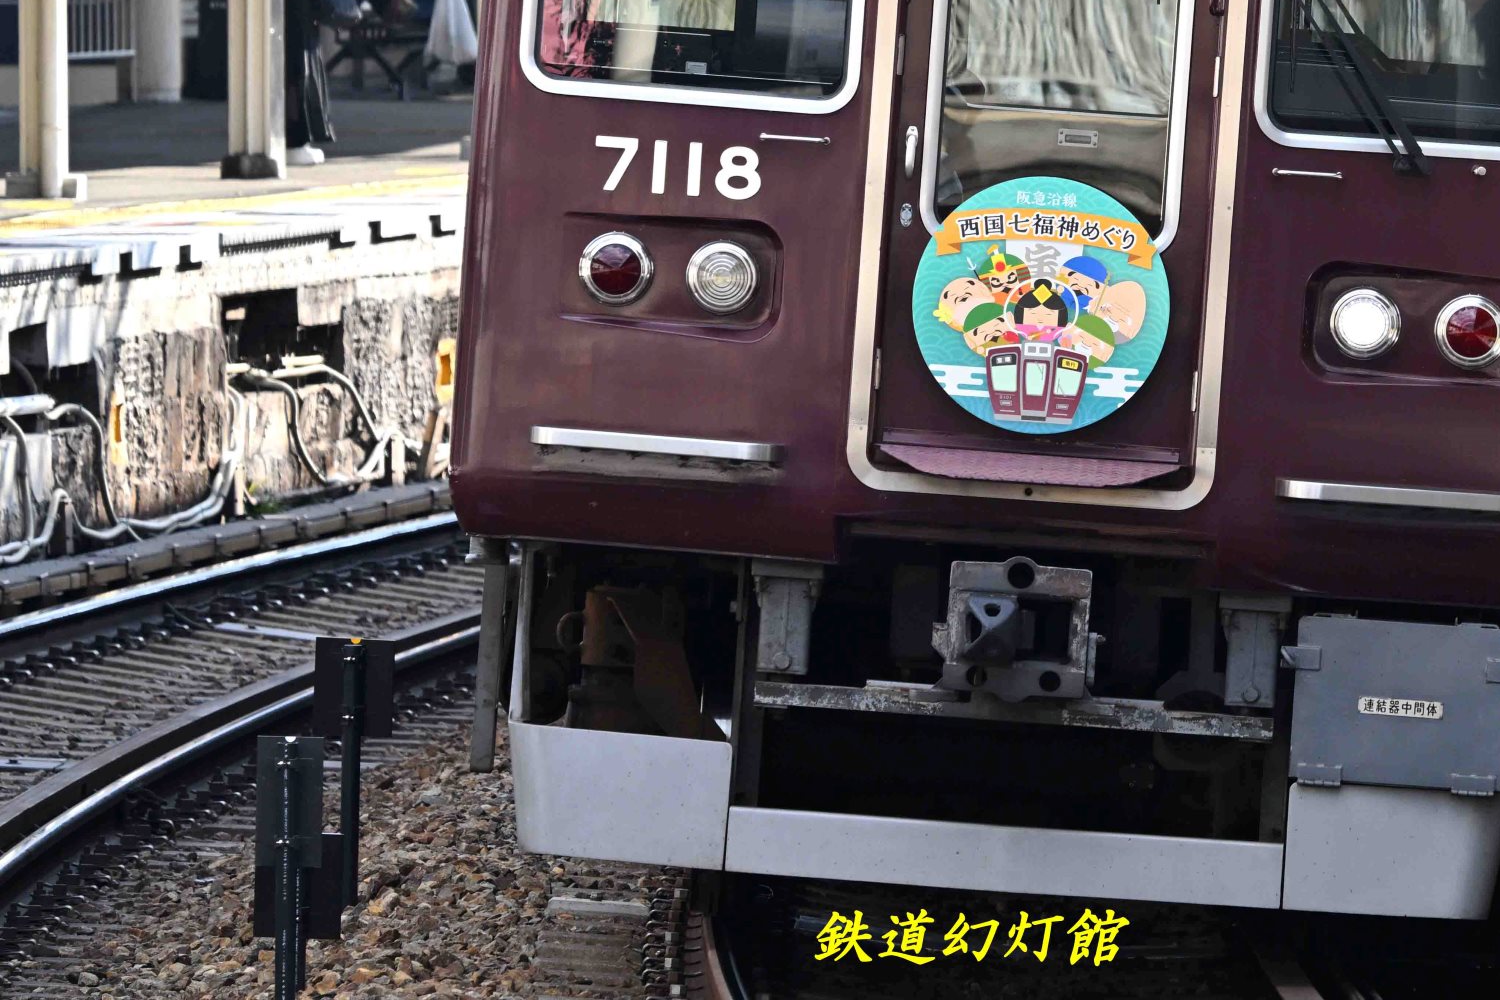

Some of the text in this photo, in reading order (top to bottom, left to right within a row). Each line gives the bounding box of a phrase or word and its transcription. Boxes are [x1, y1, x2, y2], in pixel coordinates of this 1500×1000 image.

[595, 135, 762, 200] 7118
[1016, 191, 1078, 208] 阪急沿線
[958, 213, 1136, 250] 西国七福神めぐり
[1364, 699, 1437, 717] 連結器中間体
